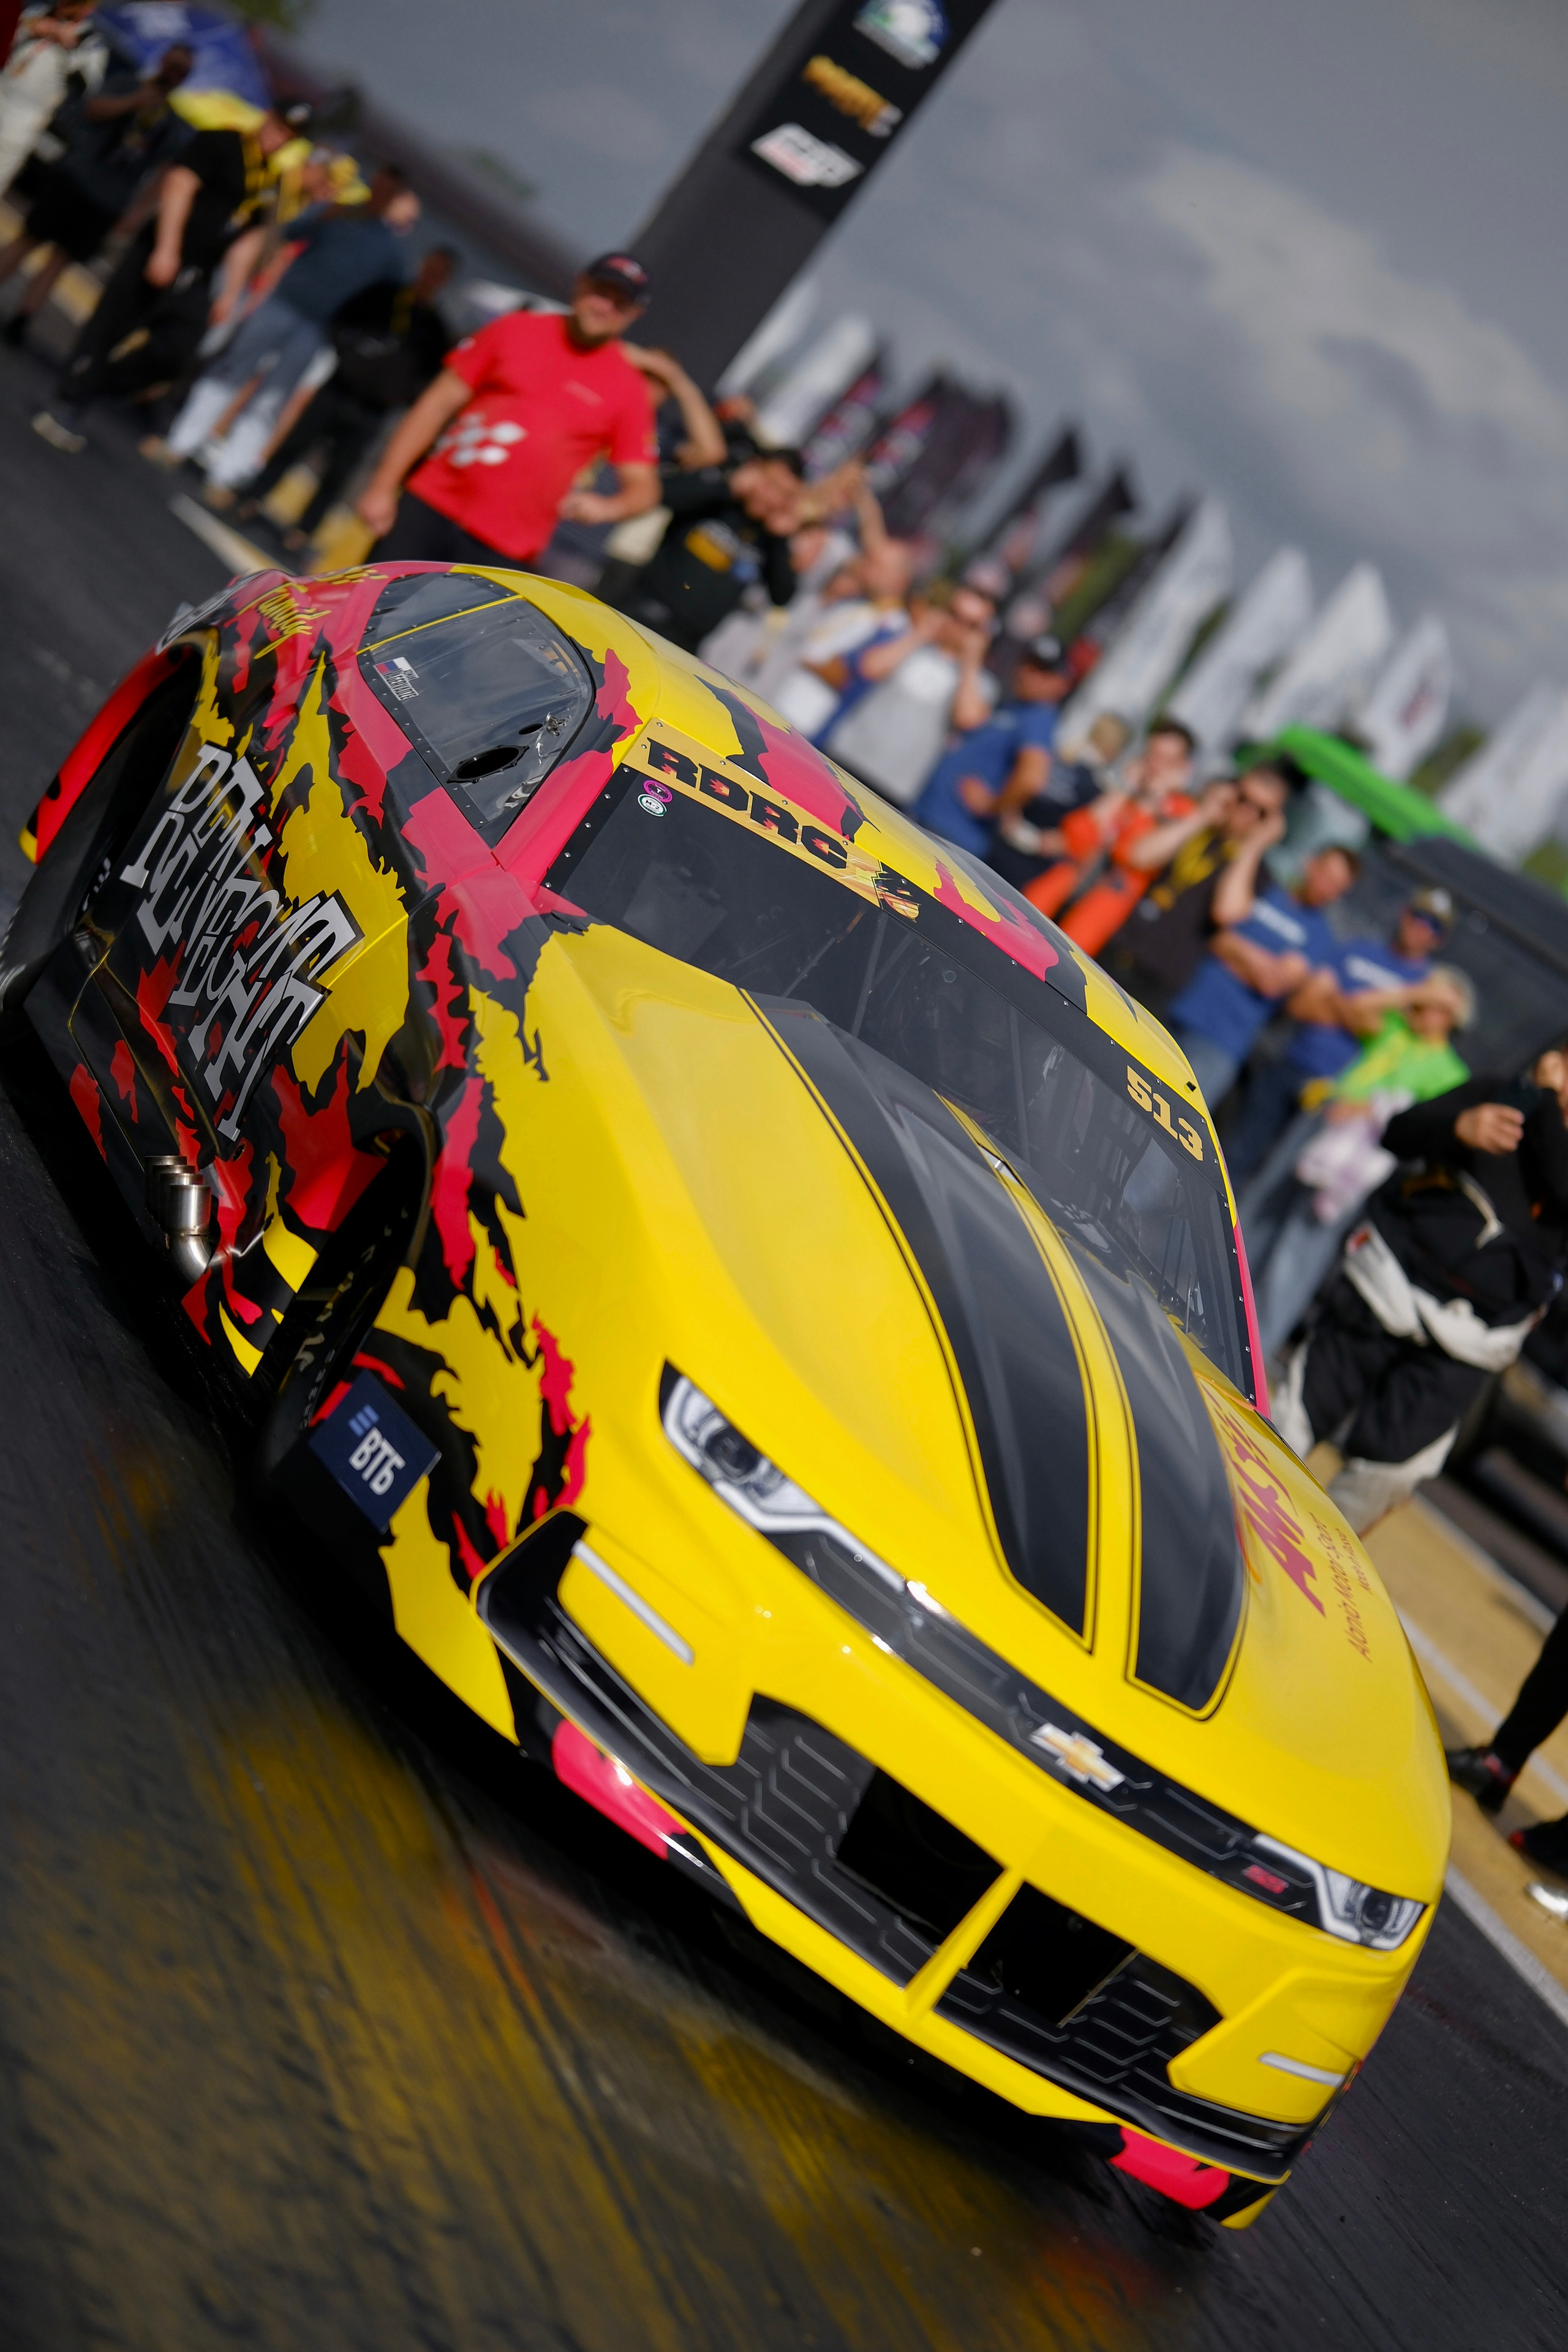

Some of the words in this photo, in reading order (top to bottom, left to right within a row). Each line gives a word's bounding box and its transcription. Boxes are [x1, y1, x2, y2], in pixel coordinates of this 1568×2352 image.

[647, 737, 848, 869] RDRC
[1127, 1065, 1203, 1161] 513
[349, 1427, 406, 1496] ВТБ
